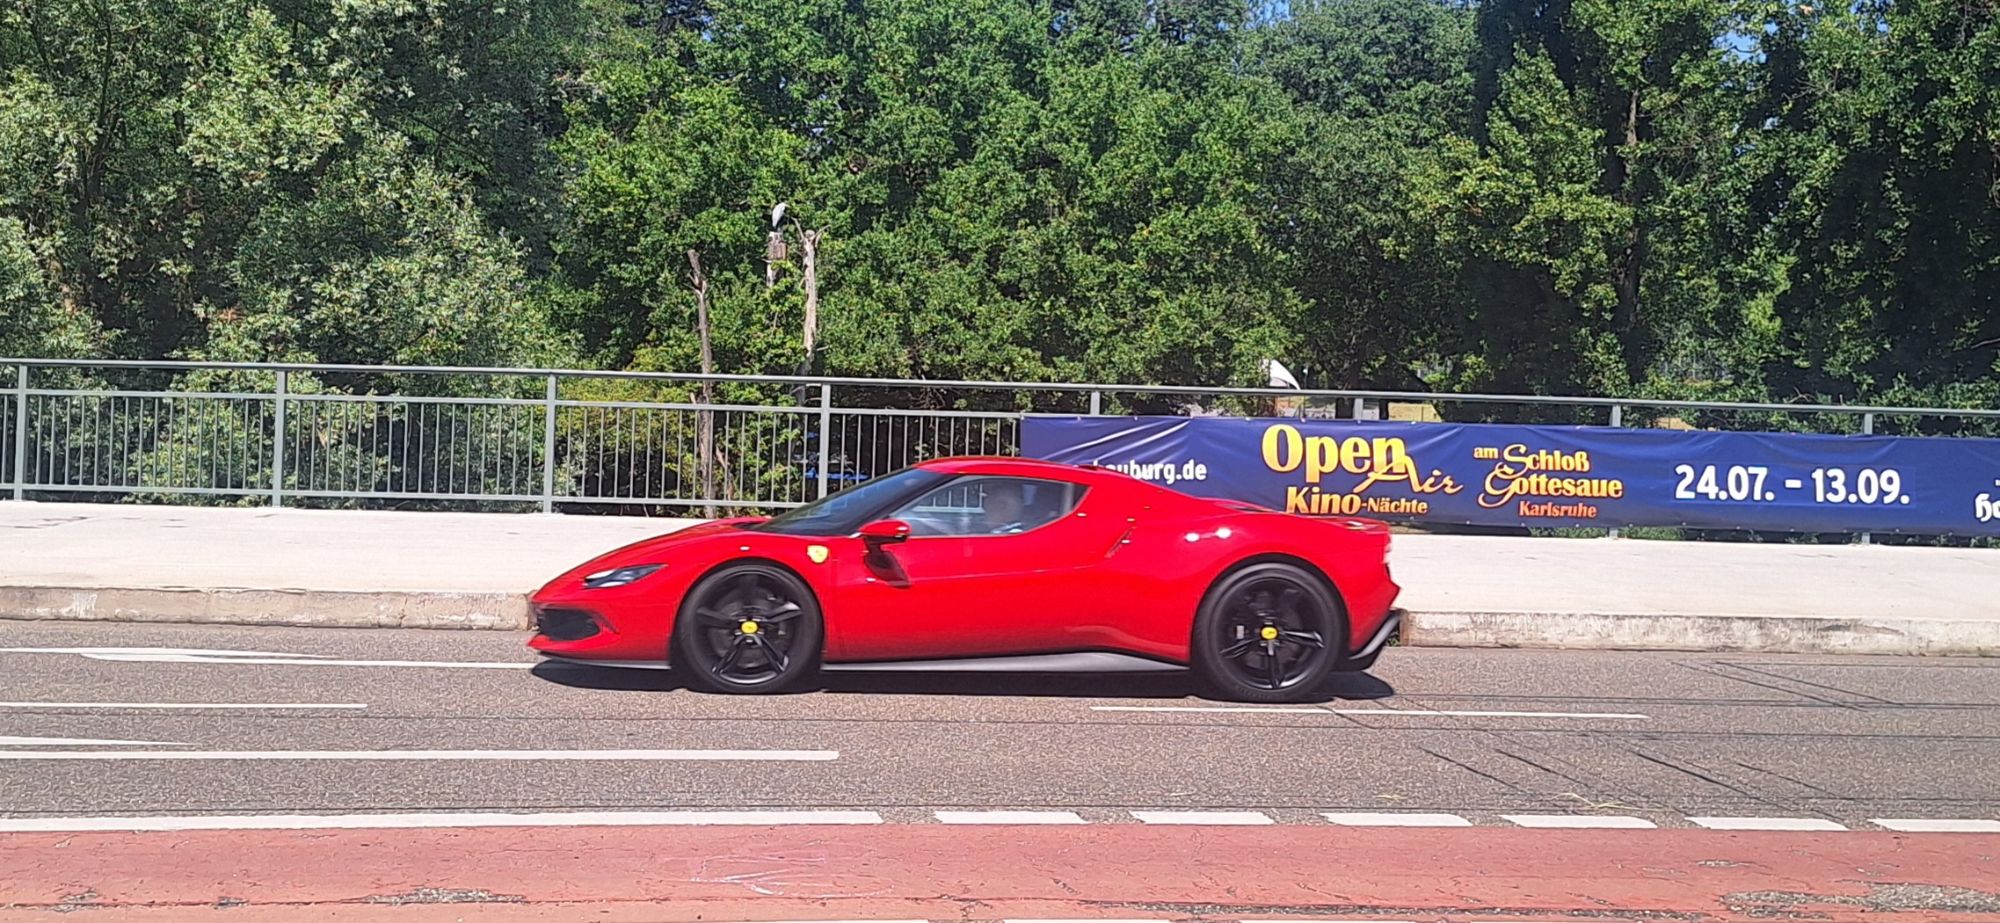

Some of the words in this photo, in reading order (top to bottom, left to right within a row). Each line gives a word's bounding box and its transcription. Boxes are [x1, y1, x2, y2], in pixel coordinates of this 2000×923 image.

[1262, 424, 1406, 483] Open
[1353, 455, 1464, 494] Air
[1473, 446, 1499, 459] am
[1495, 443, 1591, 480] Schloß
[1286, 486, 1429, 515] Kino-Nächte
[1478, 473, 1623, 508] Gottesaue
[1674, 464, 1775, 501] 24.07.
[1811, 468, 1910, 504] 13.09.
[1519, 500, 1598, 518] Karlsruhe
